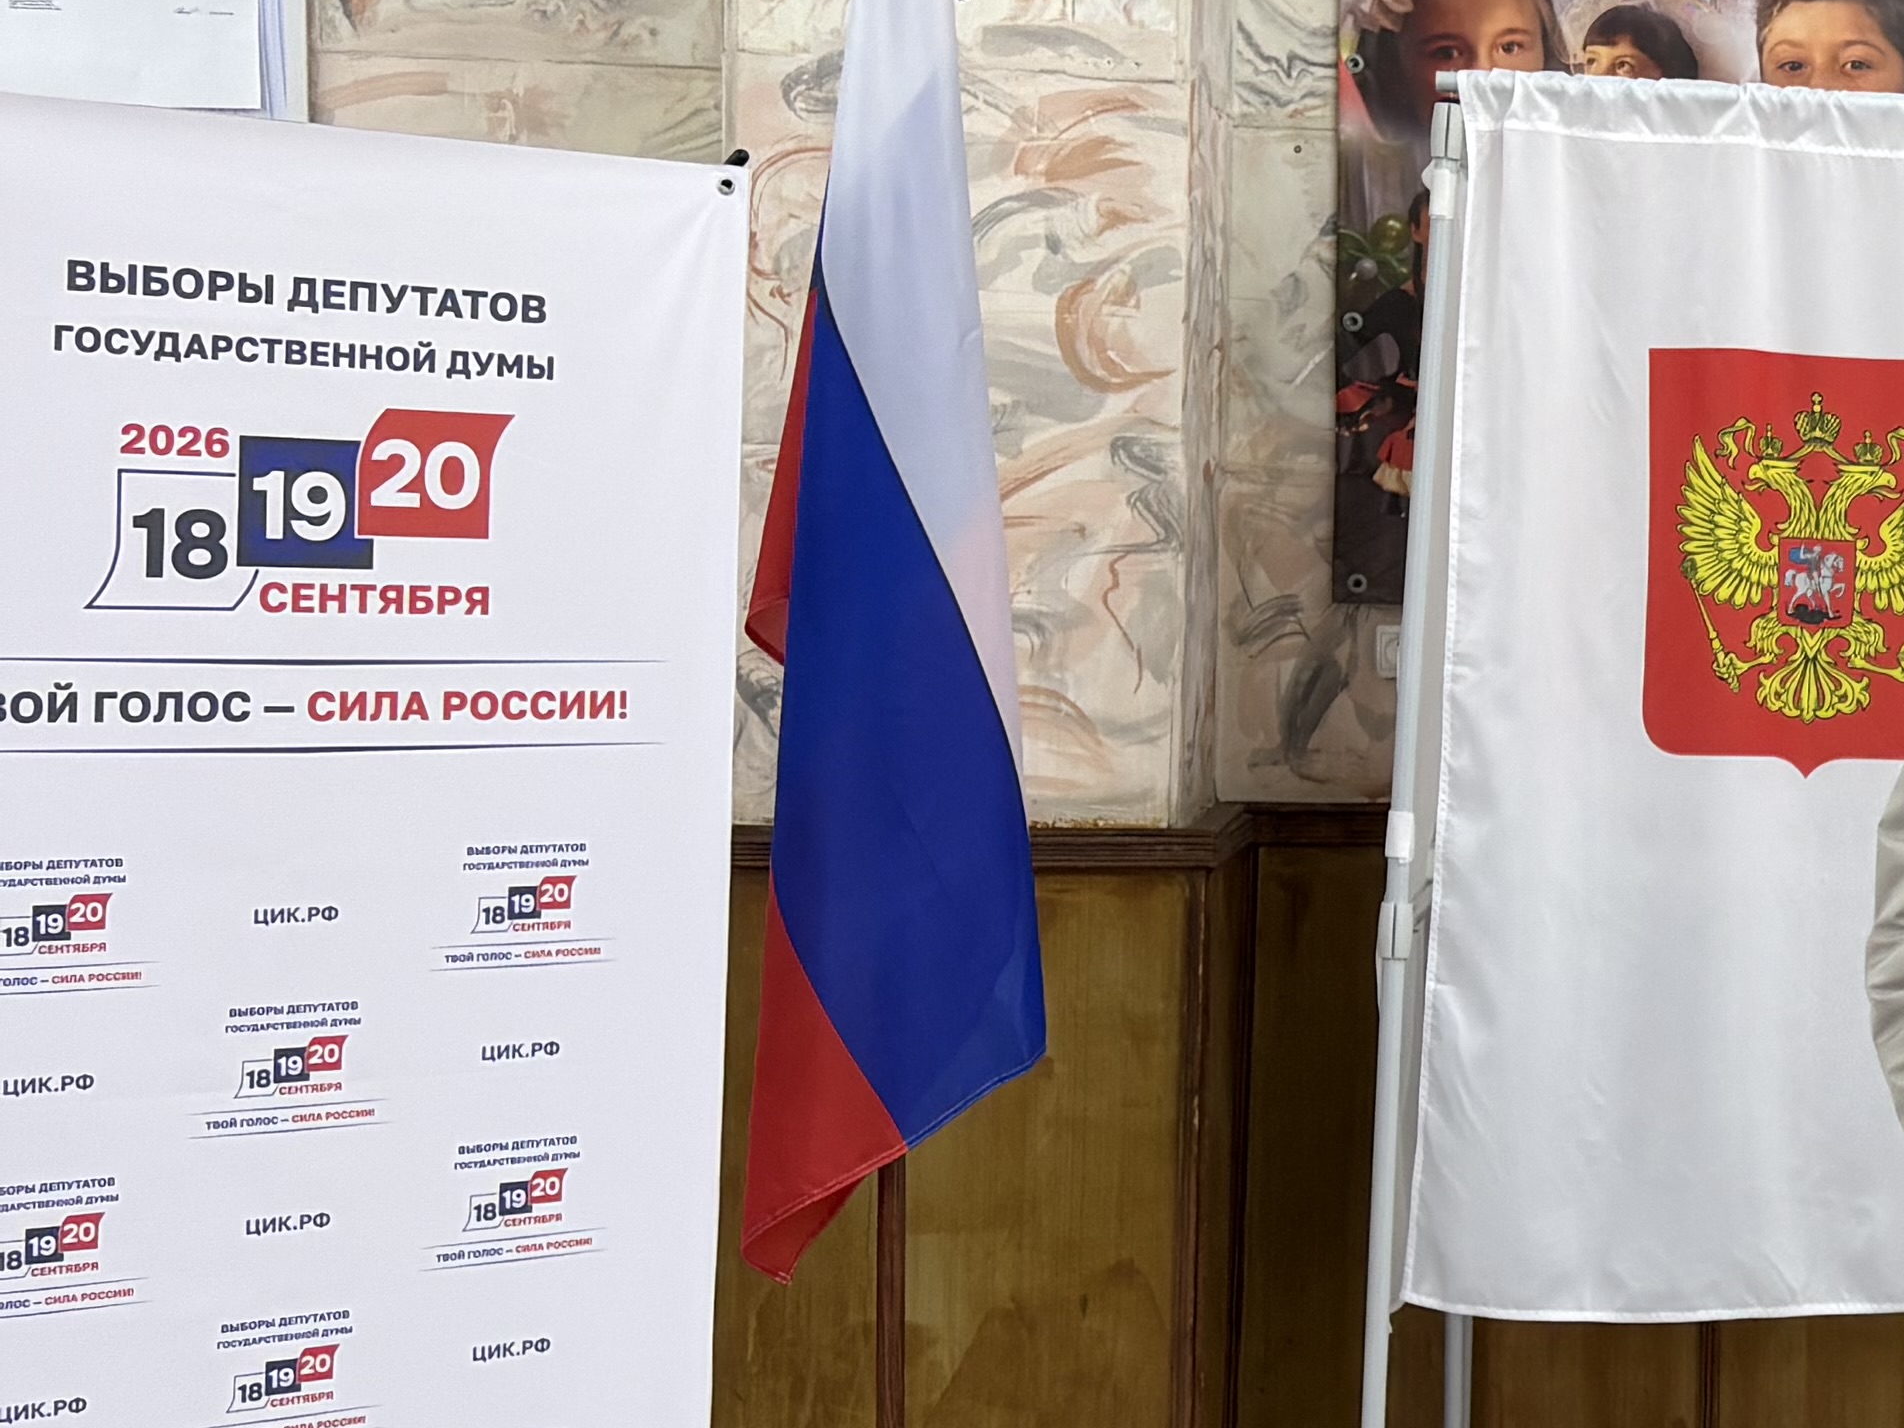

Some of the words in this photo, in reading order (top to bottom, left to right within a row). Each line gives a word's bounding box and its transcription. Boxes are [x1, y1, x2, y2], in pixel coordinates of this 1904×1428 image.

[67, 260, 273, 304] ВЫБОРЫ
[287, 277, 546, 323] ДЕПУТАТОВ
[54, 325, 436, 373] ГОСУДАРСТВЕННОЙ
[446, 350, 554, 380] ДУМЫ
[120, 424, 229, 458] 2026
[133, 508, 228, 579] 18
[253, 471, 345, 540] 19
[371, 439, 480, 509] 20
[260, 582, 489, 615] СЕНТЯБРЯ
[0, 682, 77, 723] ОЙ
[94, 691, 250, 722] ГОЛОС
[308, 691, 429, 722] СИЛА
[443, 691, 627, 720] РОССИИ!
[467, 846, 517, 856] ВЫБОРЫ
[520, 843, 586, 854] ДЕПУТАТОВ
[46, 858, 123, 870] ДЕПУТАТОВ
[254, 906, 338, 926] ЦИК.РФ
[482, 906, 505, 925] 18
[512, 894, 534, 913] 19
[540, 884, 568, 902] 20
[0, 927, 29, 947] 18
[36, 914, 63, 934] 19
[70, 902, 102, 922] 20
[513, 921, 571, 932] СЕНТЯБРЯ
[38, 942, 106, 954] СЕНТЯБРЯ
[230, 1006, 284, 1018] ВЫБОРЫ
[286, 1001, 358, 1015] ДЕПУТАТОВ
[482, 1041, 560, 1062] ЦИК.РФ
[246, 1069, 271, 1089] 18
[278, 1056, 302, 1076] 19
[309, 1044, 339, 1064] 20
[3, 1074, 94, 1097] ЦИК.РФ
[279, 1082, 342, 1095] СЕНТЯБРЯ
[458, 1142, 509, 1154] ВЫБОРЫ
[512, 1136, 577, 1151] ДЕПУТАТОВ
[38, 1177, 115, 1194] ДЕПУТАТОВ
[474, 1203, 496, 1222] 18
[503, 1189, 526, 1208] 19
[532, 1177, 560, 1196] 20
[246, 1213, 330, 1236] ЦИК.РФ
[504, 1214, 562, 1227] СЕНТЯБРЯ
[29, 1236, 56, 1256] 19
[63, 1222, 95, 1243] 20
[31, 1262, 98, 1276] СЕНТЯБРЯ
[221, 1318, 275, 1333] ВЫБОРЫ
[278, 1310, 350, 1328] ДЕПУТАТОВ
[473, 1338, 550, 1362] ЦИК.РФ
[238, 1382, 262, 1403] 18
[269, 1368, 294, 1388] 19
[300, 1354, 330, 1374] 20
[270, 1391, 333, 1407] СЕНТЯБРЯ
[0, 1398, 86, 1424] ЦИК.РФ
